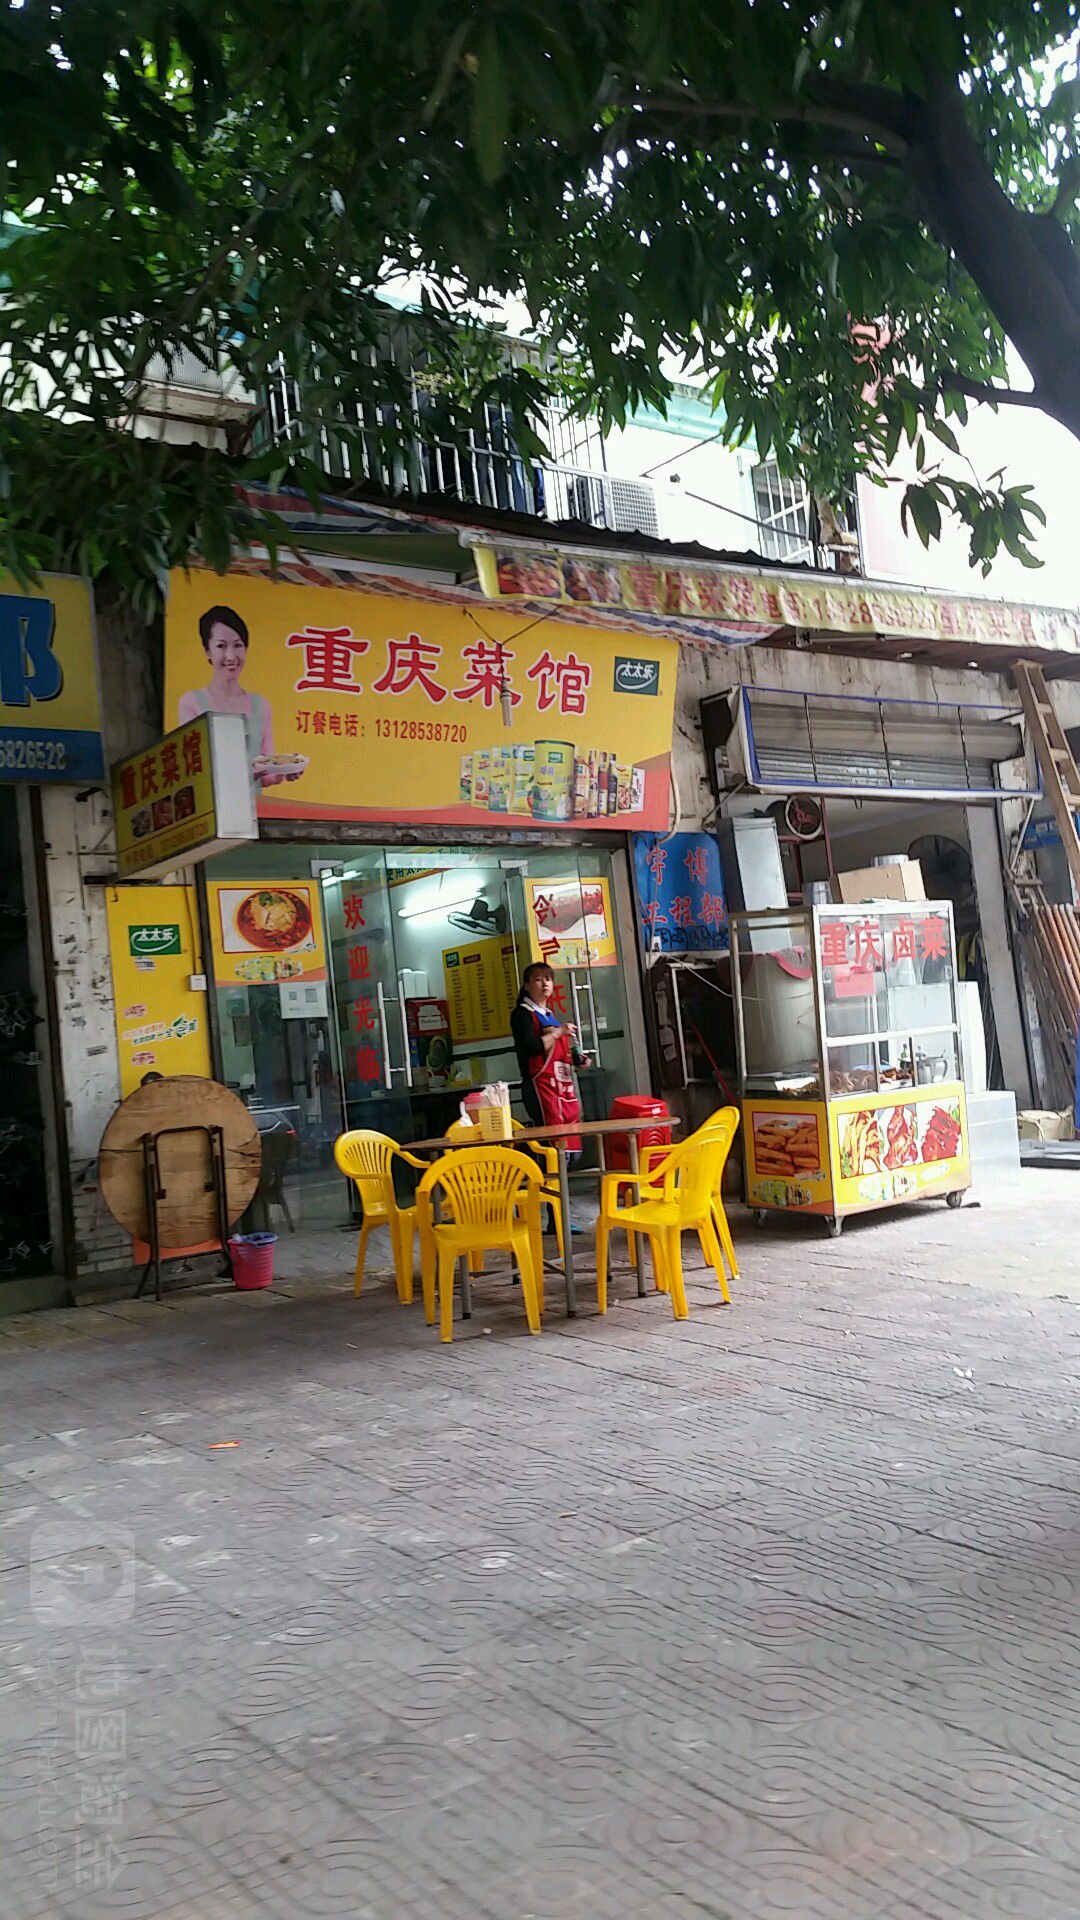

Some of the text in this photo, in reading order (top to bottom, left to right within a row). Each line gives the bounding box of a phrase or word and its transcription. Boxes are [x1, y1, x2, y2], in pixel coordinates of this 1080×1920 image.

[287, 627, 591, 715] 重庆菜馆
[620, 660, 655, 681] 太太乐
[120, 730, 203, 810] 重庆菜馆
[137, 927, 174, 942] 太太乐
[642, 892, 725, 931] 工程部
[820, 916, 948, 967] 重庆卤菜
[342, 894, 381, 1082] 欢迎光临
